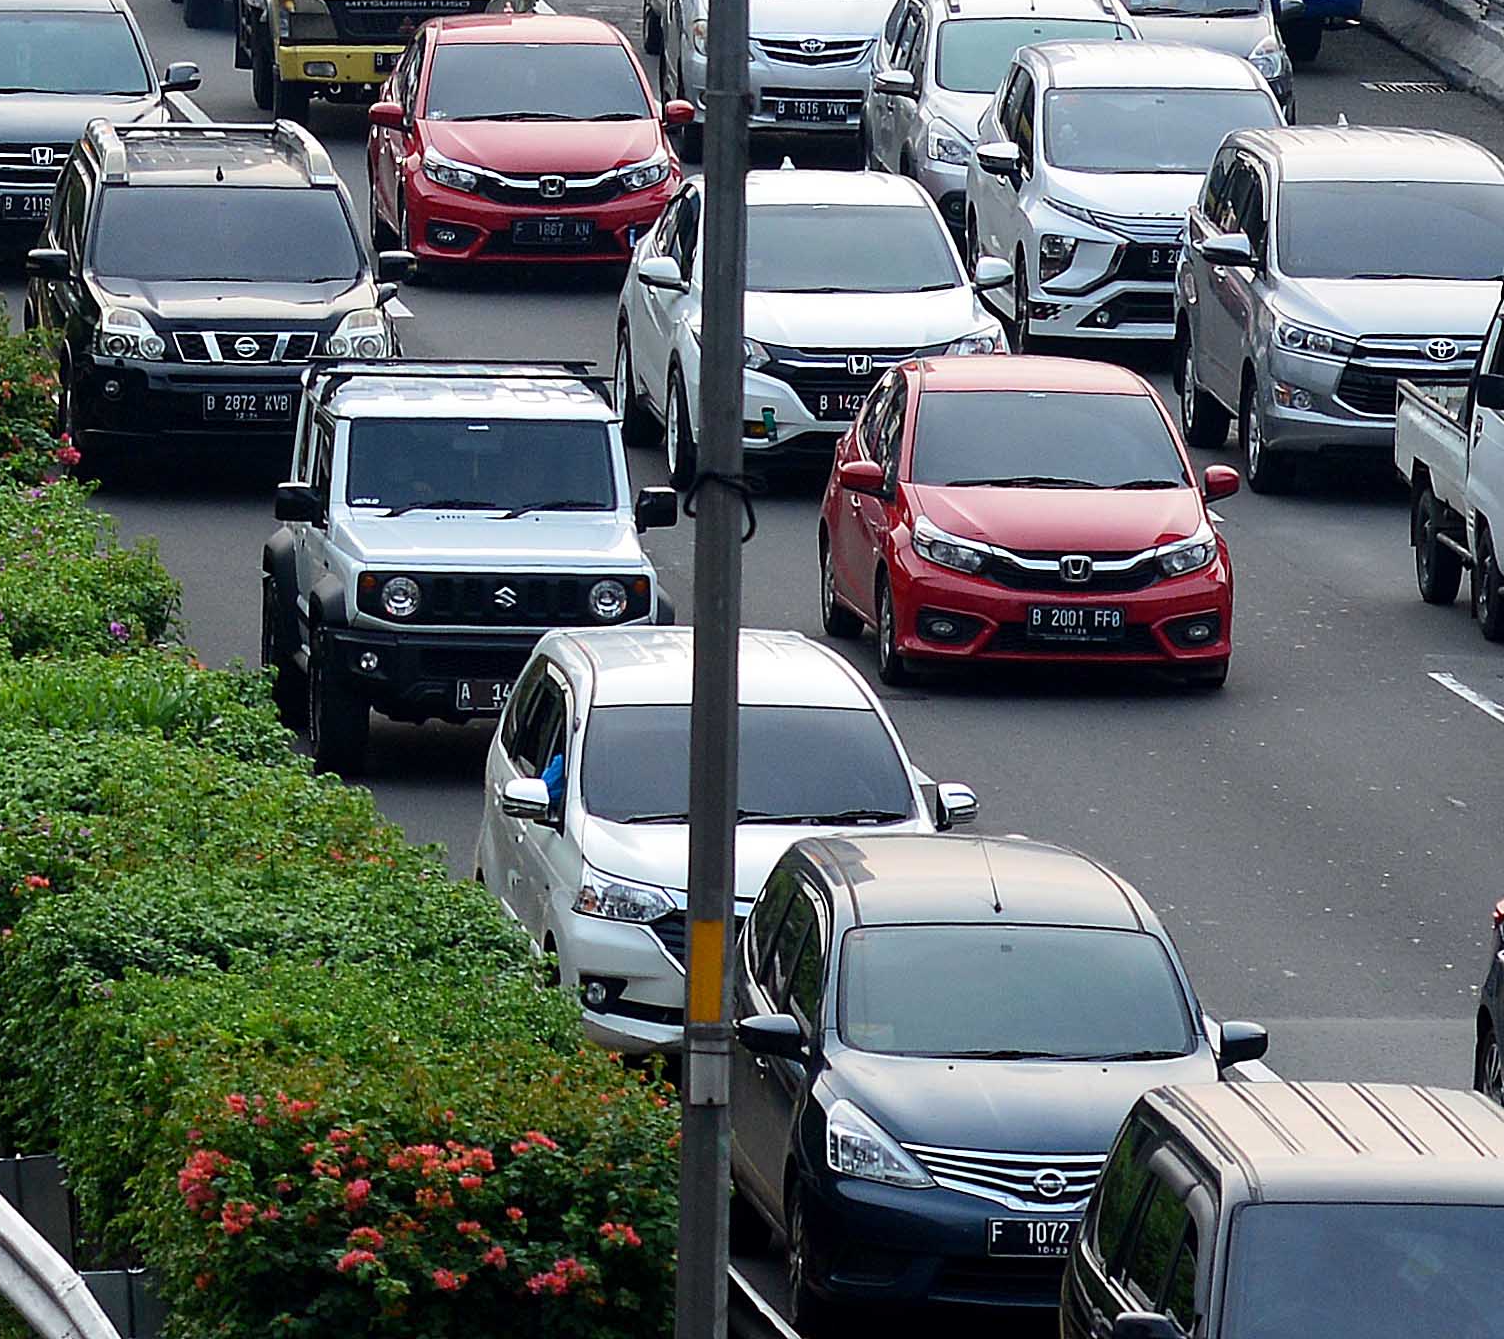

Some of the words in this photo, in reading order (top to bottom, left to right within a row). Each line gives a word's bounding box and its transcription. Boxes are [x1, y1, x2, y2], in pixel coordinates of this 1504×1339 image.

[429, 0, 471, 10] FUSO
[777, 101, 785, 115] B
[794, 101, 819, 115] 1816
[5, 197, 13, 211] B
[515, 221, 524, 233] F
[538, 221, 564, 236] 1867
[1151, 249, 1160, 264] B
[206, 395, 215, 412] B
[224, 395, 257, 412] 2872
[264, 395, 289, 412] KVB
[820, 394, 828, 411] B
[1032, 609, 1041, 626] B
[1051, 609, 1084, 627] 2001
[461, 682, 470, 700] A
[991, 1221, 1003, 1245] F
[1027, 1220, 1070, 1245] 1072
